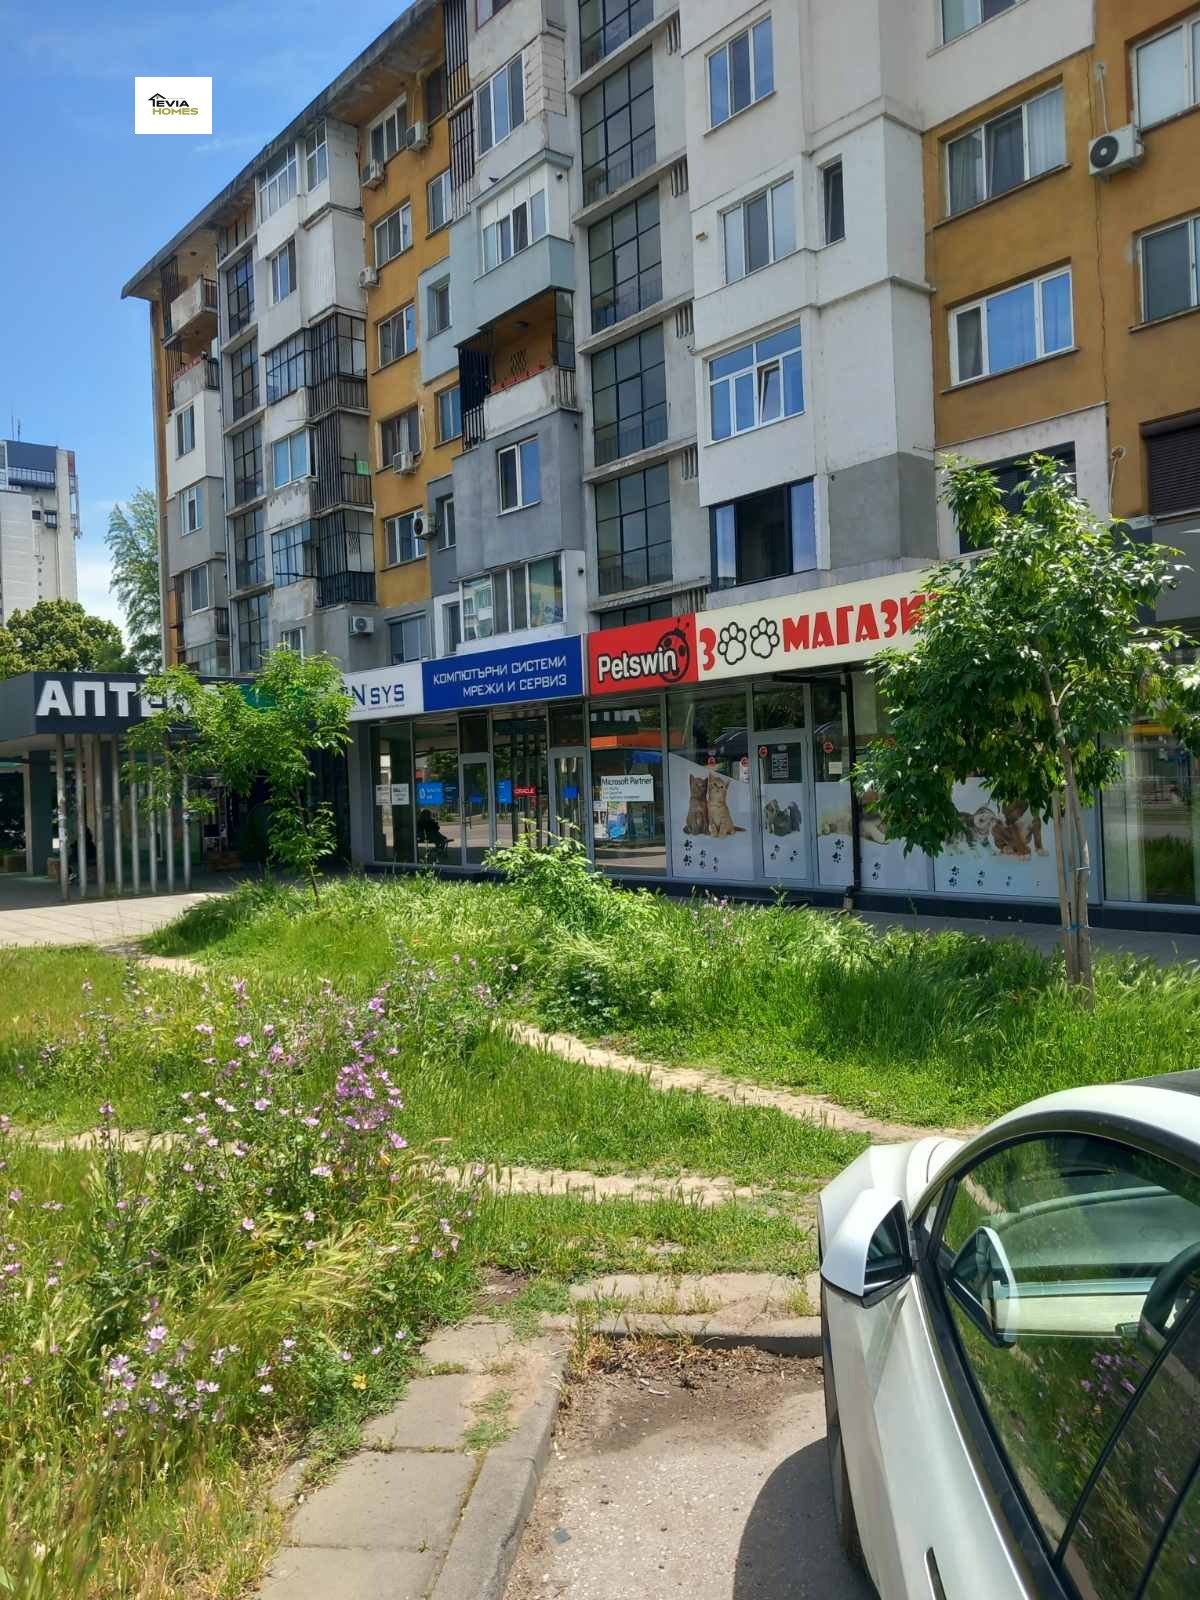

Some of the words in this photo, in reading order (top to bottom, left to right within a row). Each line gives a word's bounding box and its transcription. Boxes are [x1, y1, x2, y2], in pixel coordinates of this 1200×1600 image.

[782, 593, 938, 653] МАГАЗИ
[433, 664, 508, 685] КОМПЮТЪРНИ
[511, 656, 567, 674] СИСТЕМИ
[598, 646, 678, 682] Petswin
[371, 684, 405, 705] SYS
[463, 682, 504, 698] МРЕЖИ
[507, 681, 516, 693] И
[520, 674, 567, 691] СЕРВИЗ
[602, 776, 629, 786] Microsoft
[630, 775, 653, 785] Partner
